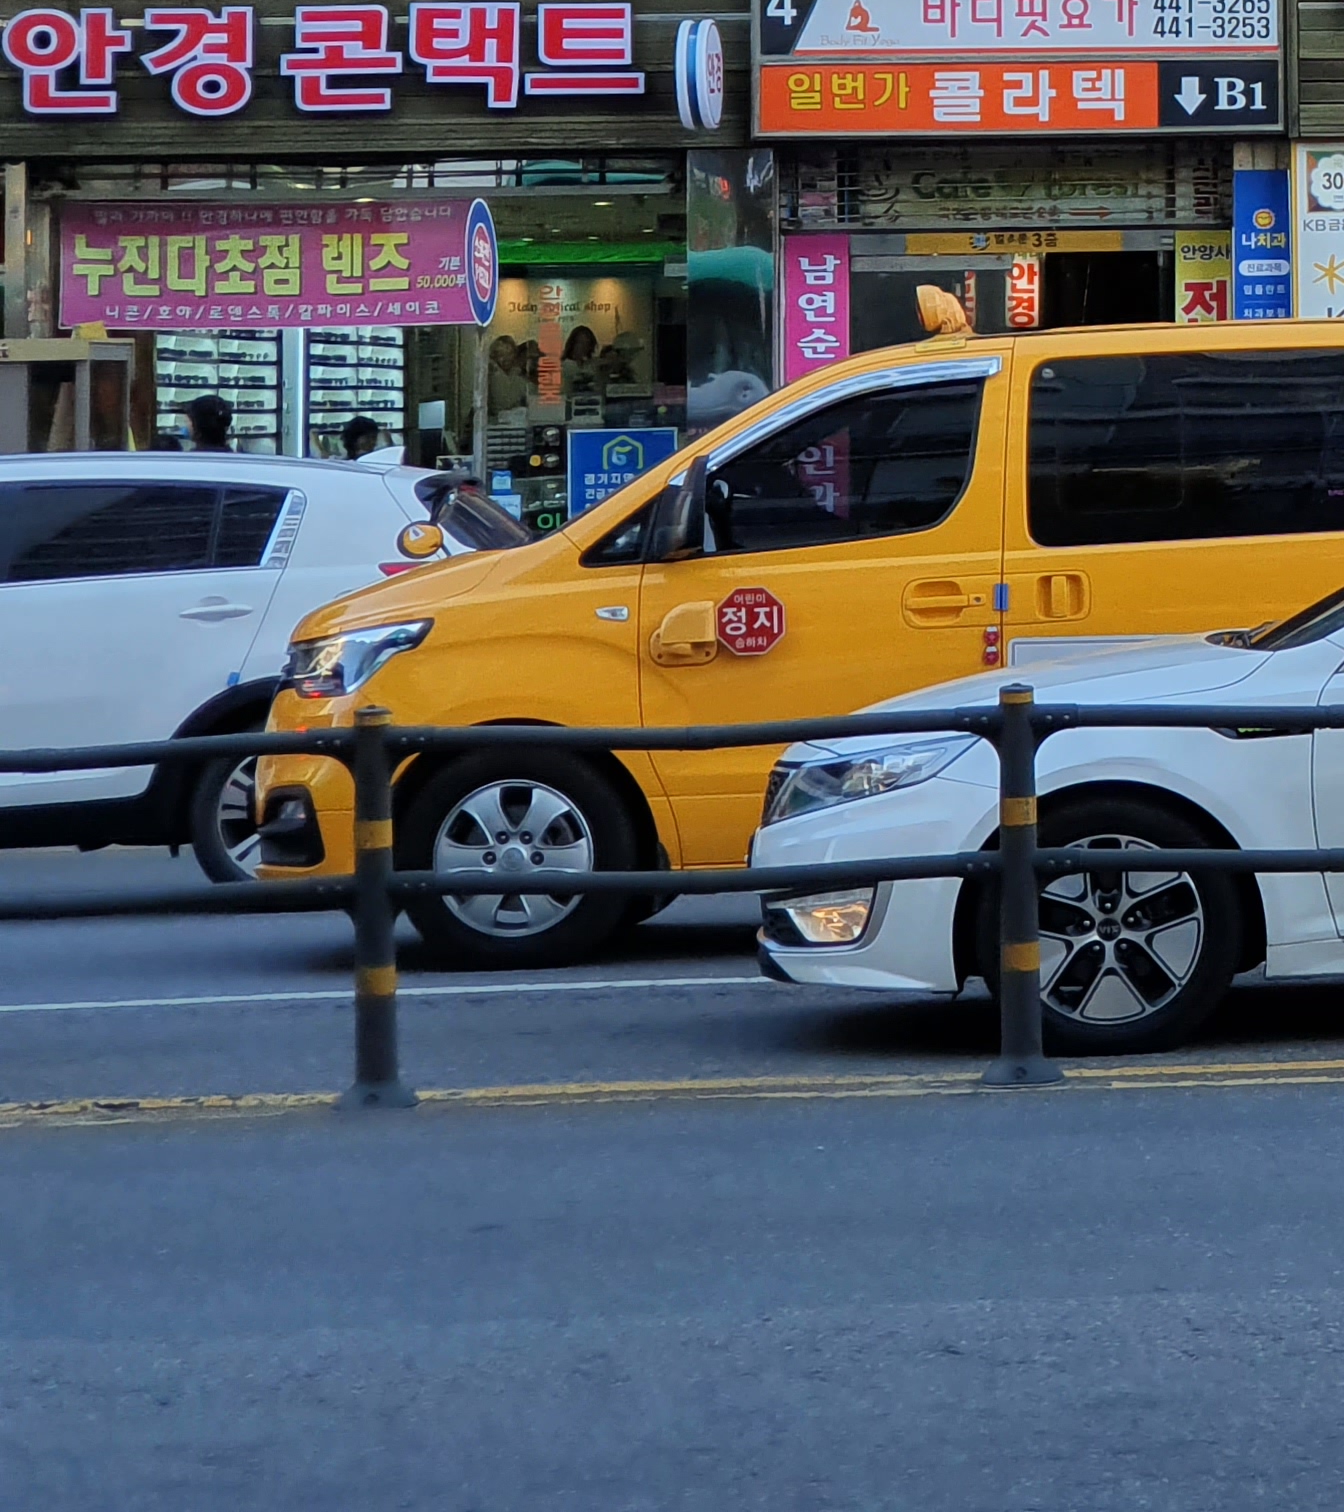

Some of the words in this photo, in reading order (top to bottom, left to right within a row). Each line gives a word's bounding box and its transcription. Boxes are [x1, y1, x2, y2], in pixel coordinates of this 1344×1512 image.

[1153, 17, 1271, 40] 441-3253
[2, 6, 255, 115] 안경
[280, 2, 645, 111] 콘택트
[787, 71, 911, 111] 일번가
[929, 68, 1127, 122] 콜라텍
[1214, 77, 1268, 111] B1
[1180, 243, 1232, 261] 안양사
[1241, 231, 1287, 250] 나치과
[73, 233, 301, 297] 누진다초점
[321, 232, 411, 295] 렌즈
[797, 254, 841, 360] 남연순
[1008, 262, 1039, 328] 안경
[734, 593, 766, 605] 어린이
[721, 605, 778, 635] 정지
